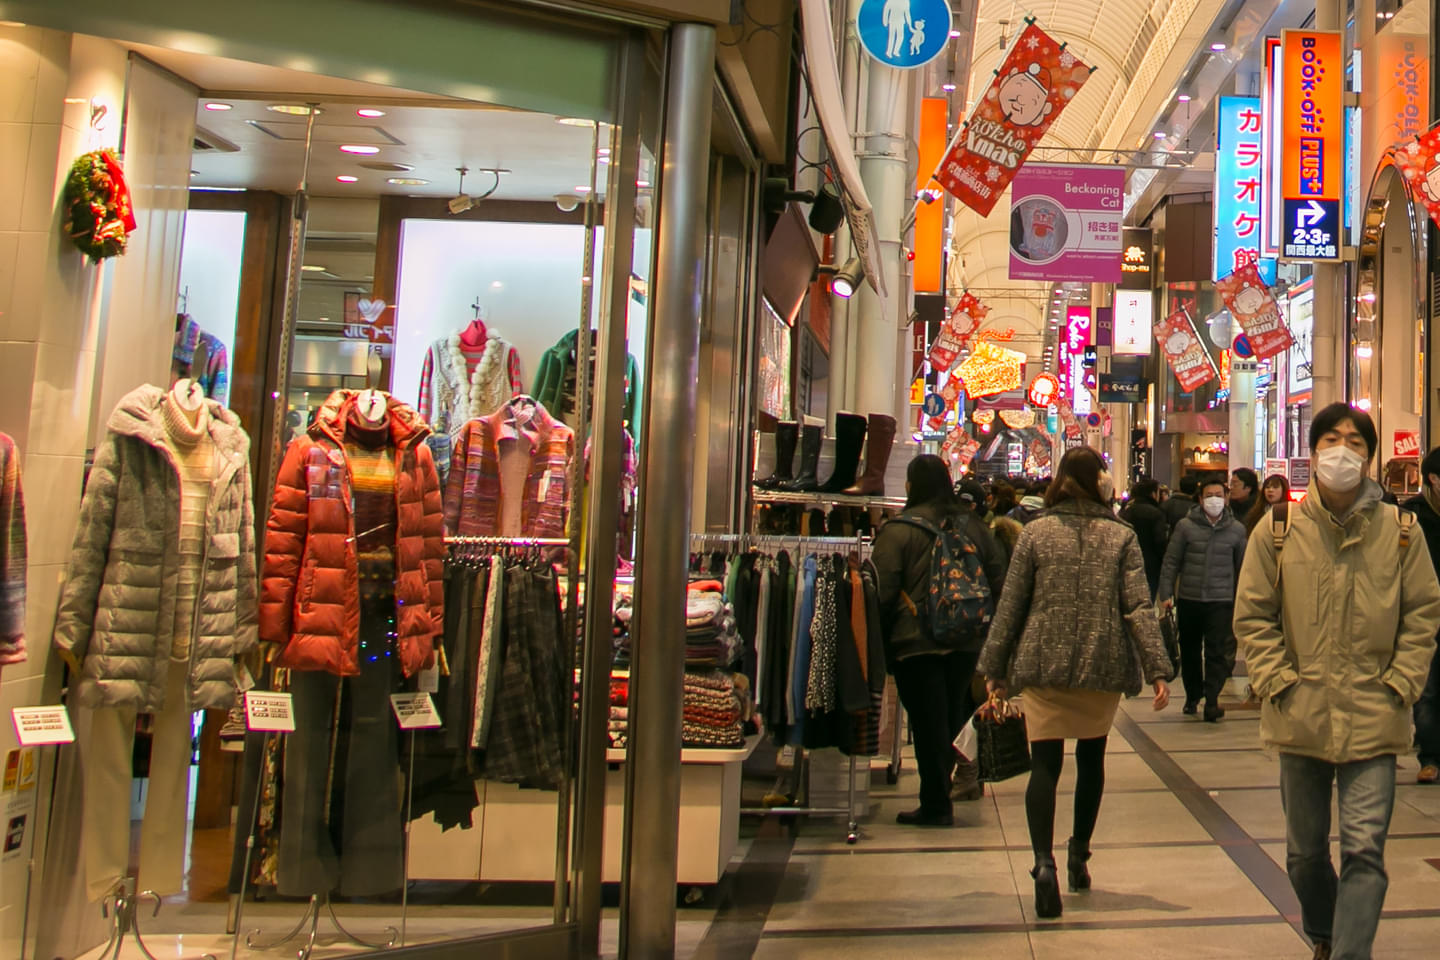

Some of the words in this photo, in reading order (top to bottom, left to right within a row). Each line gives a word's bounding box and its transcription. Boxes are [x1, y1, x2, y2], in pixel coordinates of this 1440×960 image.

[959, 130, 1021, 168] Xmas
[1065, 183, 1120, 197] Beckoning
[1101, 197, 1120, 207] Cat
[1234, 108, 1260, 271] カラオケ館
